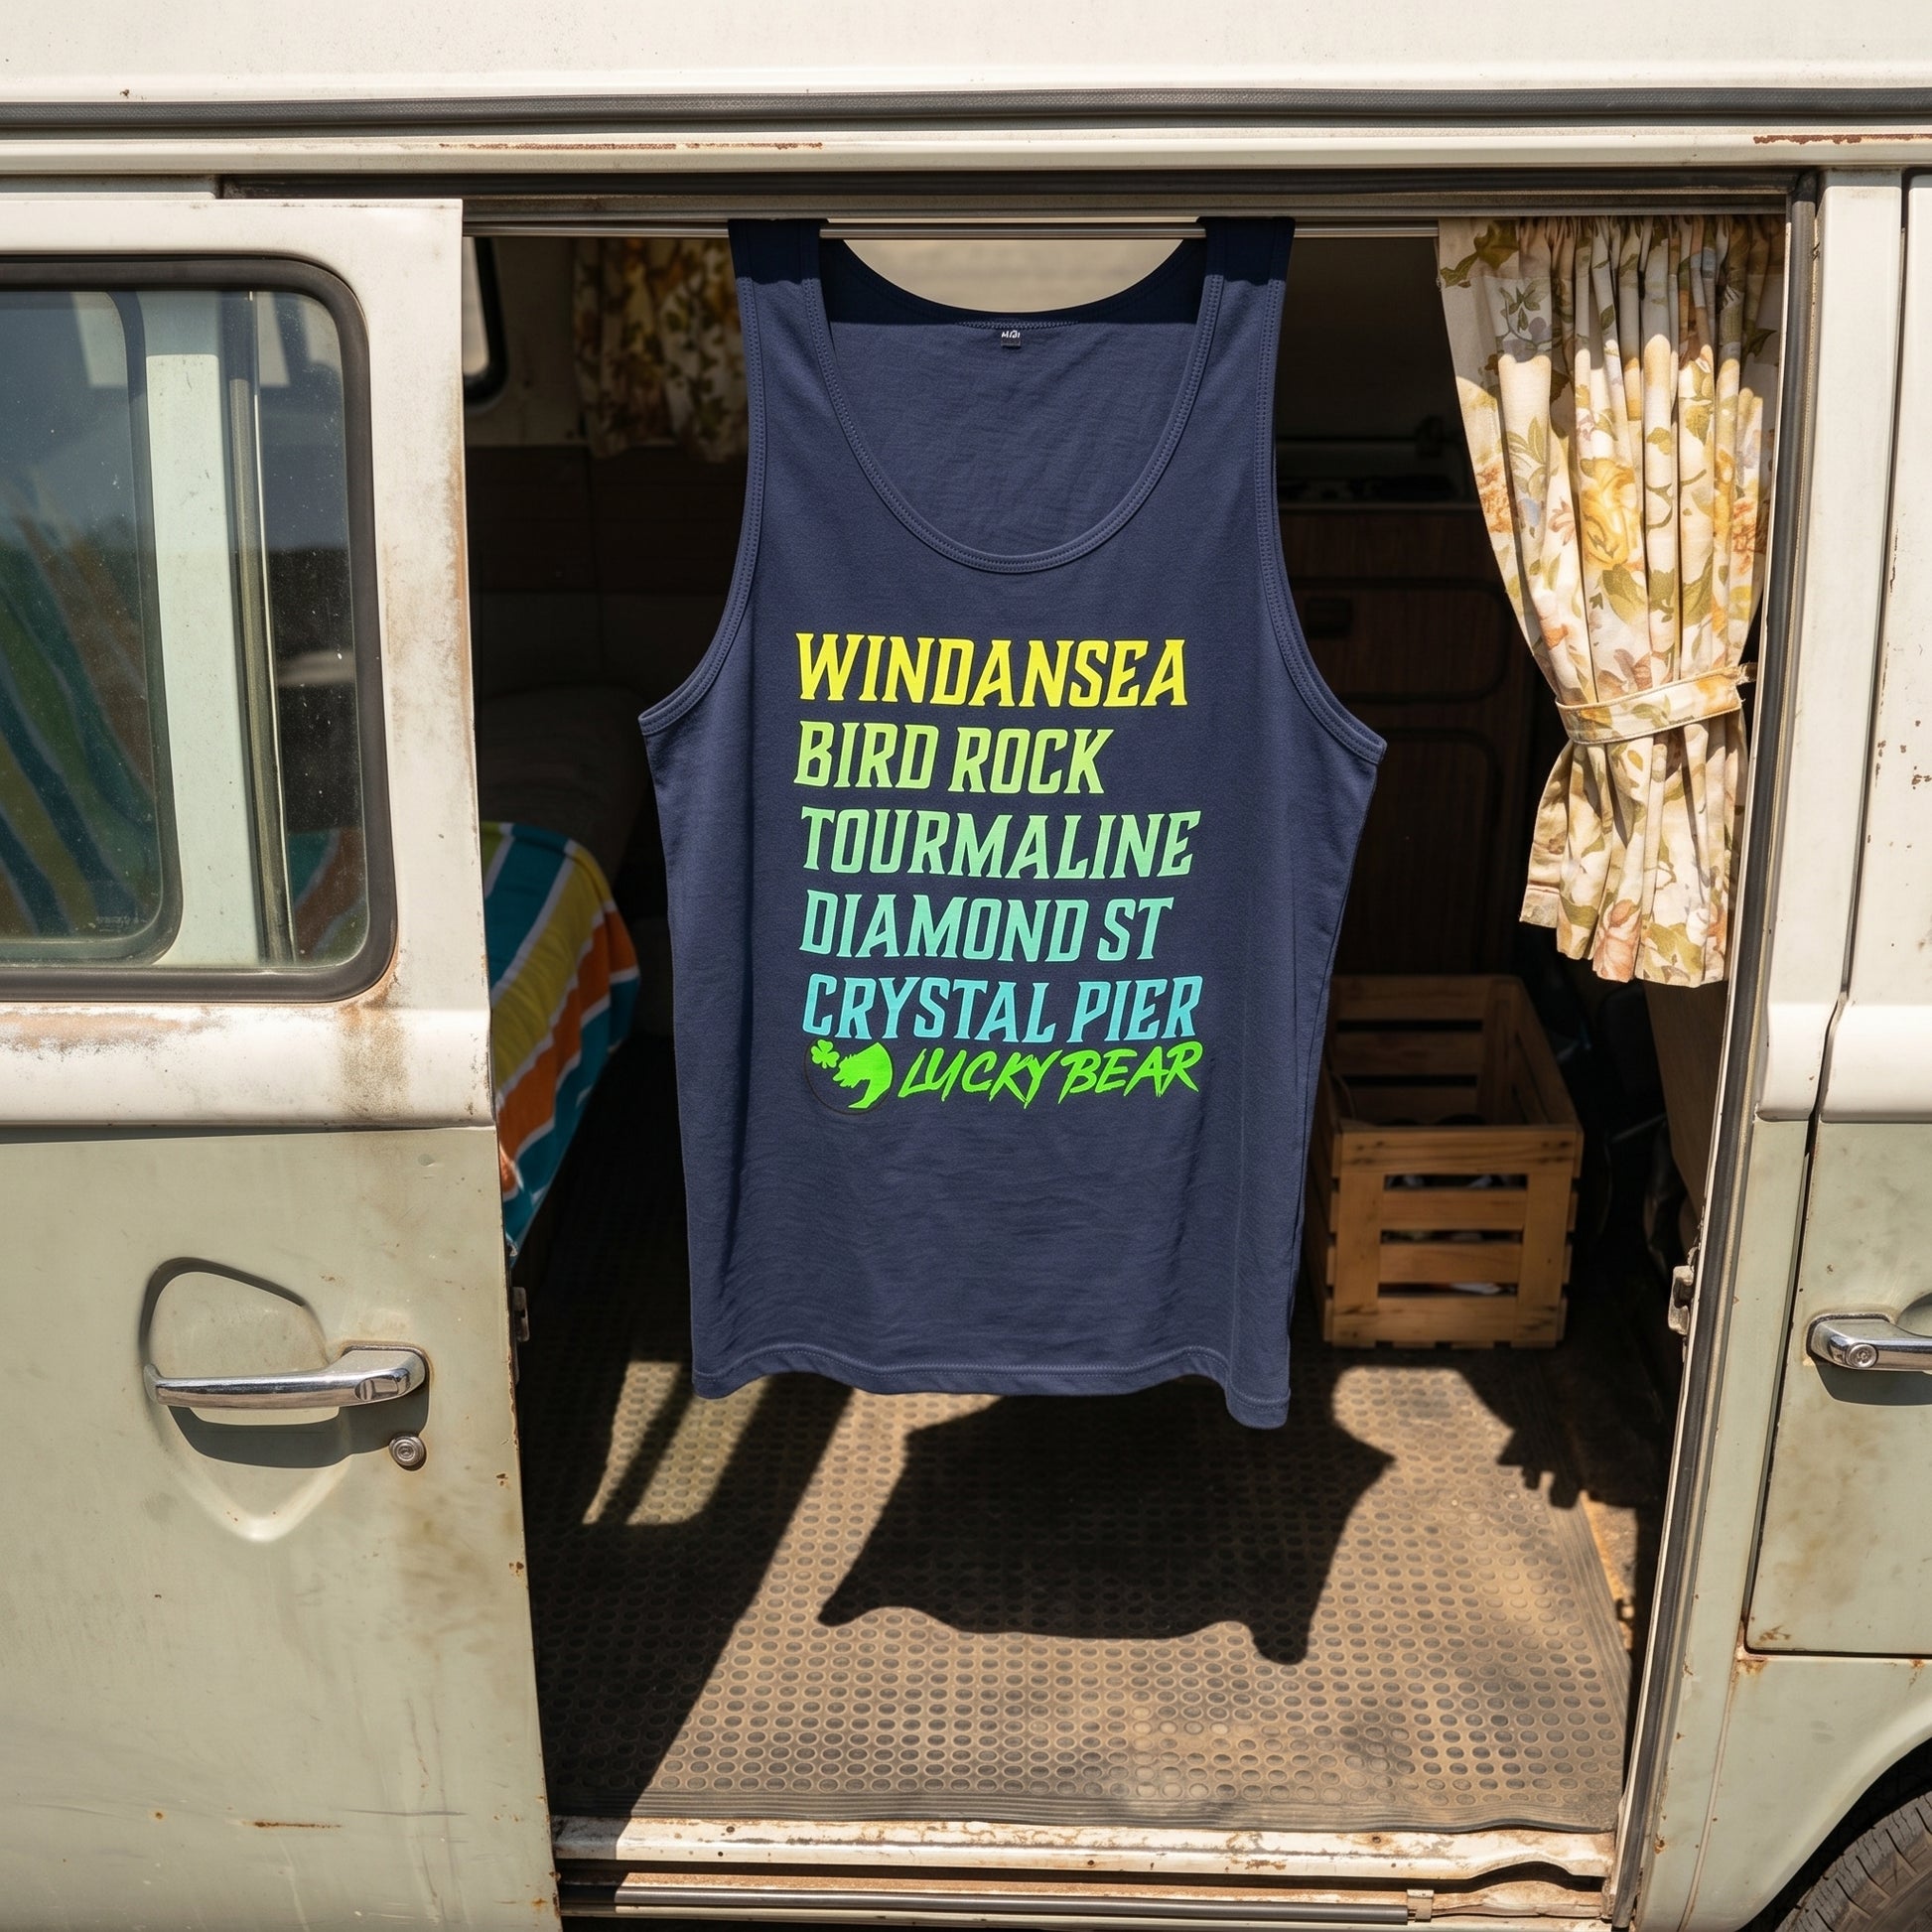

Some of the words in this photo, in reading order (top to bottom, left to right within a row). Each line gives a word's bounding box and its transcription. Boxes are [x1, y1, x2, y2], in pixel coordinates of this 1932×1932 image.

[795, 632, 1188, 708] WINDANSEA
[793, 720, 940, 790] BIRD
[948, 726, 1114, 794] ROCK
[800, 805, 1201, 879] TOURMALINE
[799, 889, 1090, 963] DIAMOND
[1097, 897, 1175, 961] ST
[802, 973, 1057, 1043] CRYSTAL
[1066, 975, 1204, 1043] PIER
[897, 1046, 1062, 1109] LUCKY
[1057, 1040, 1204, 1104] BEAR
